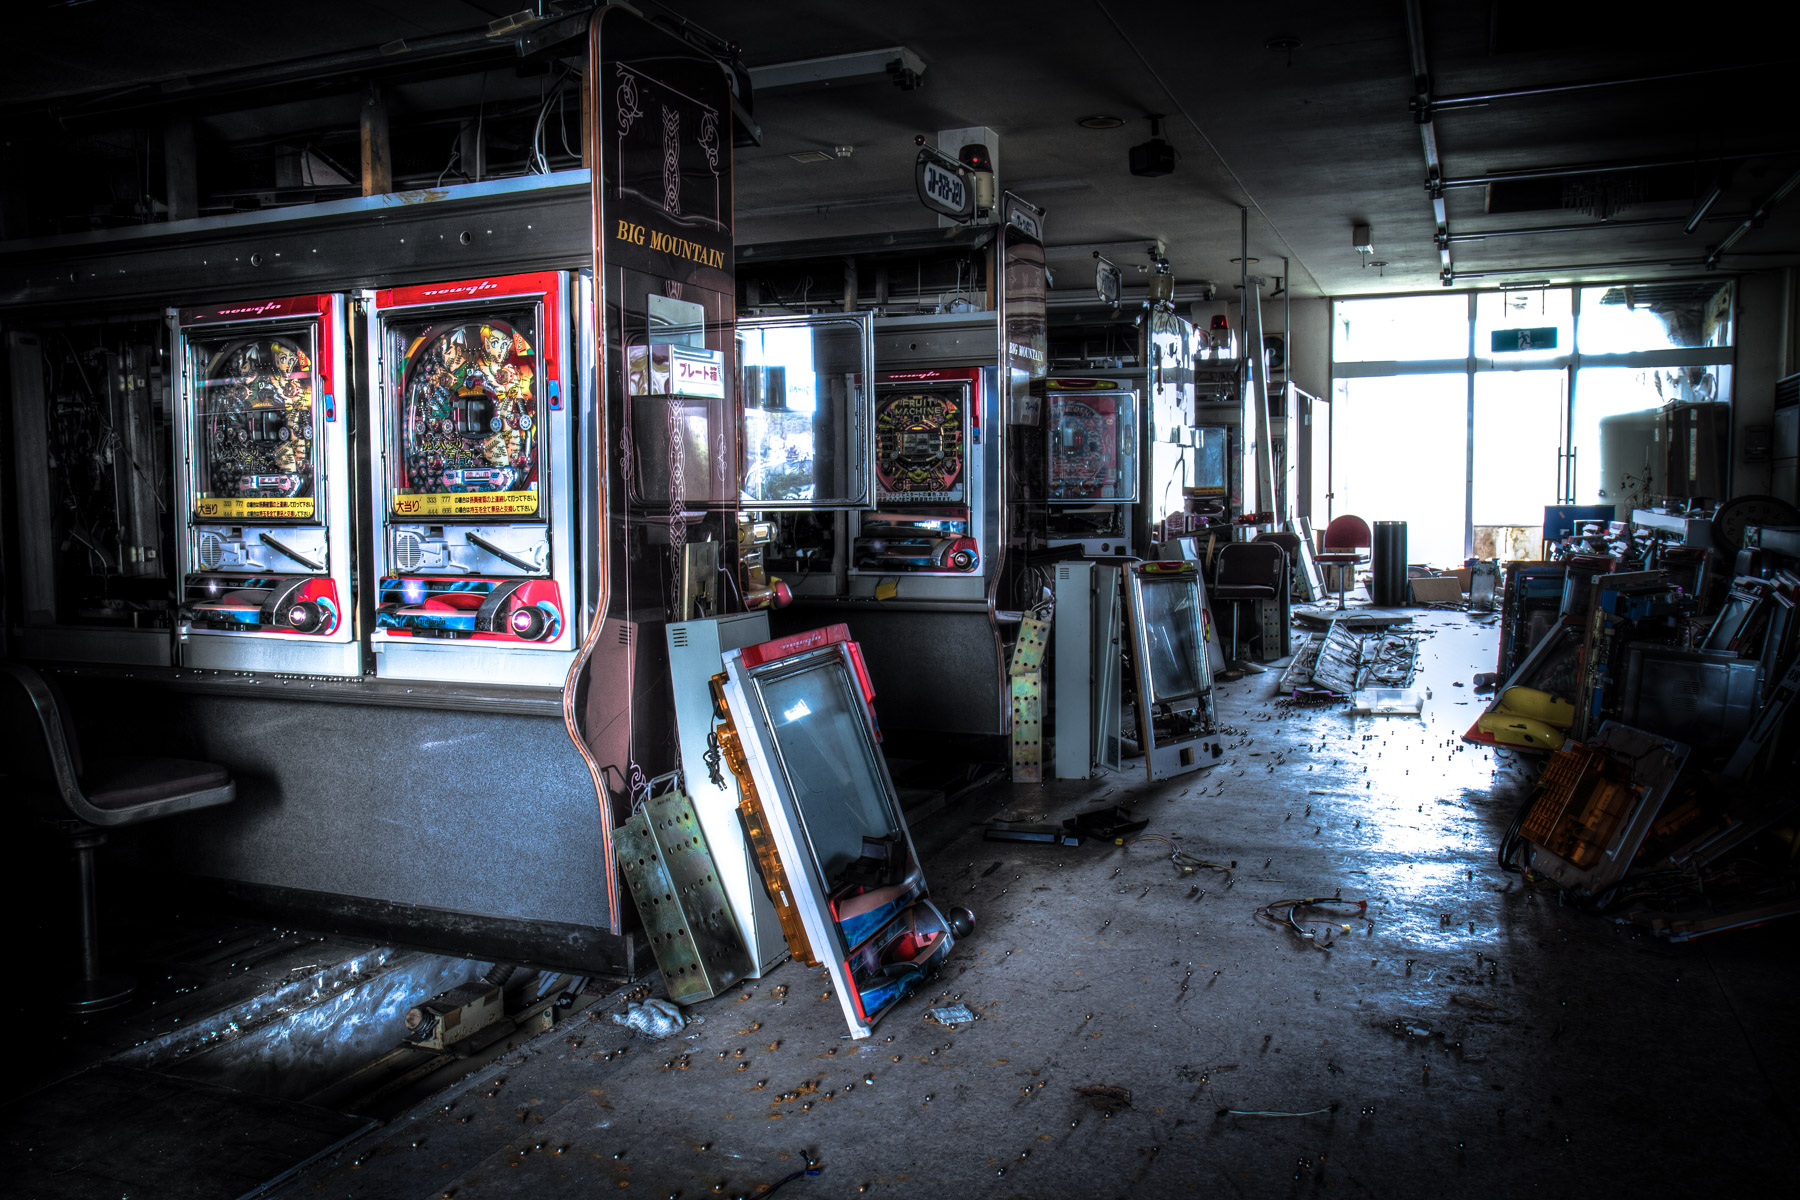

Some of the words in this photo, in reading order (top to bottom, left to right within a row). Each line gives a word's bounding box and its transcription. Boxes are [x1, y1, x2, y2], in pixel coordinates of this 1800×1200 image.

[616, 220, 646, 246] BIG
[649, 230, 725, 270] MOUNTAIN
[1009, 341, 1019, 356] BIG
[1018, 345, 1044, 362] MOUNTAIN
[903, 399, 934, 407] FRUIT
[895, 406, 941, 415] MACHINE
[197, 503, 218, 515] 大当り
[395, 500, 420, 514] 大当り
